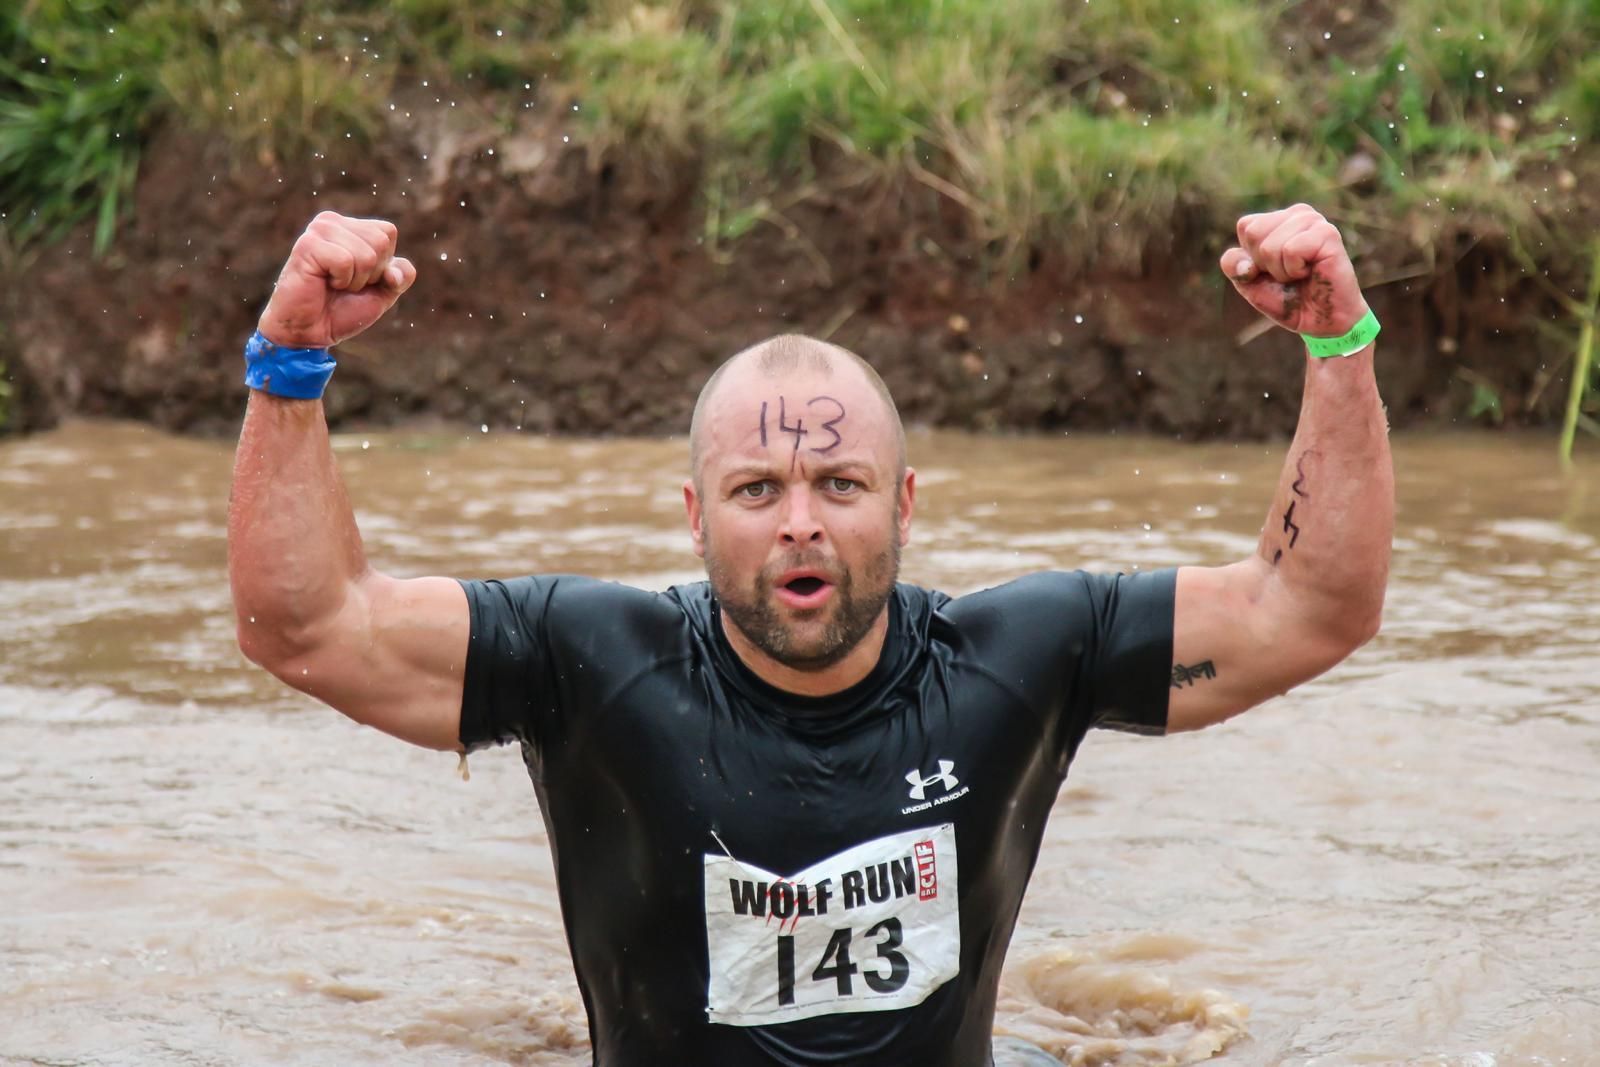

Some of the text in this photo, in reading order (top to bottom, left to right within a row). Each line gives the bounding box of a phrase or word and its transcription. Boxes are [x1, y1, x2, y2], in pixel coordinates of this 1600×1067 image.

[760, 395, 845, 453] 143
[902, 786, 970, 815] UNDER ARMOUR
[729, 856, 917, 920] WOLF RUN
[916, 844, 936, 888] CLIF
[777, 916, 910, 1007] 143
